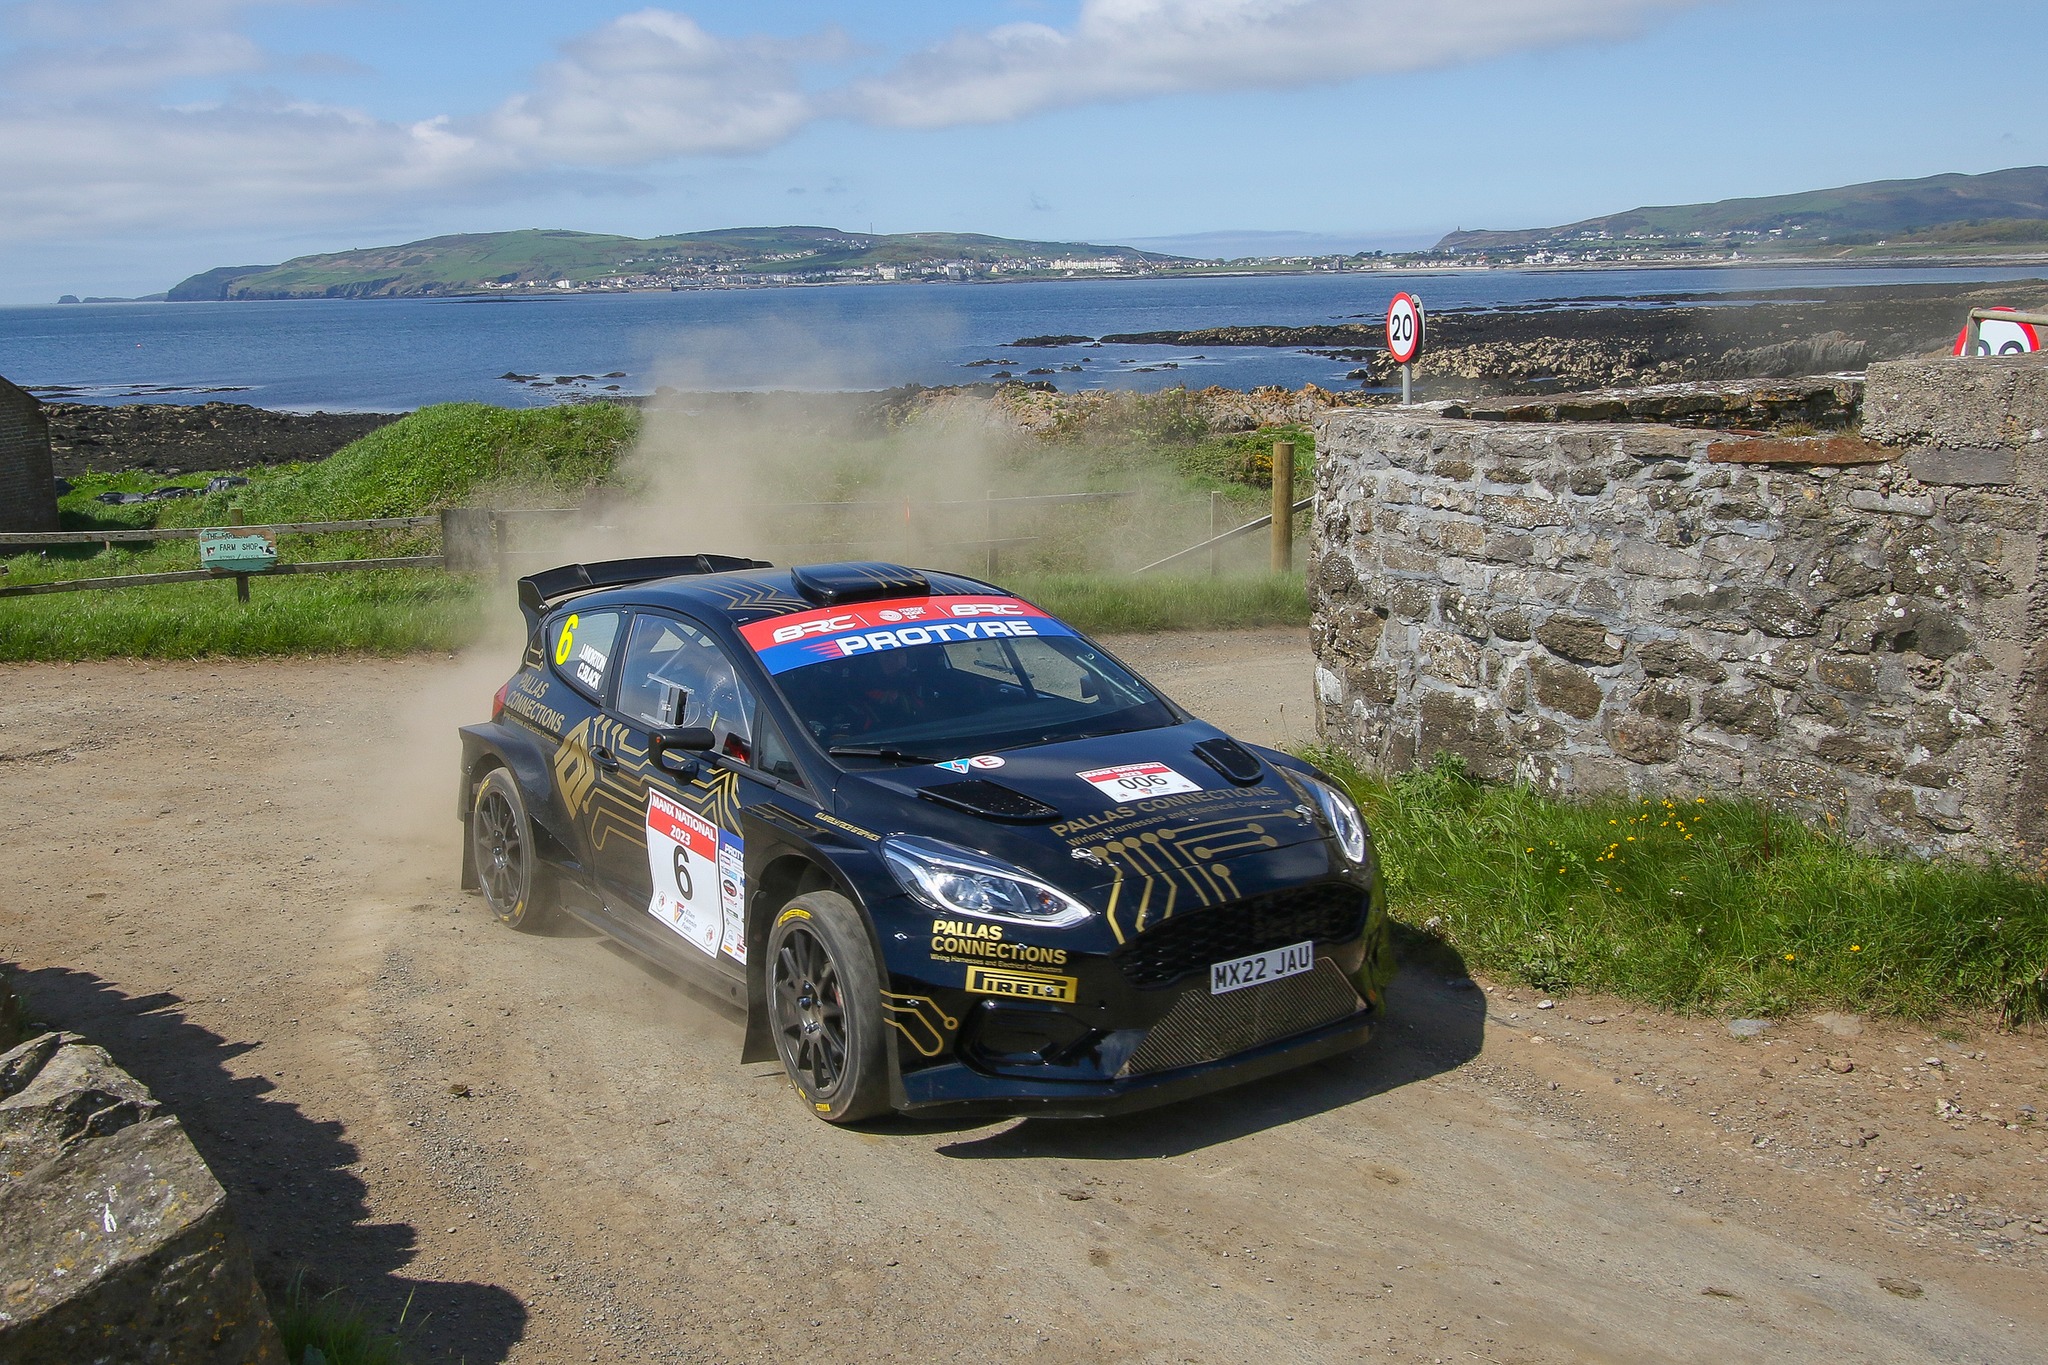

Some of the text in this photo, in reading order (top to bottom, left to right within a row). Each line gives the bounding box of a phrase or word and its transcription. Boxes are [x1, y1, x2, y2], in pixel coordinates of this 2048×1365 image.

[1392, 314, 1413, 341] 20
[220, 542, 259, 551] FARM SHOP
[950, 603, 1026, 617] BRC
[555, 613, 579, 666] 6
[772, 614, 857, 644] BRC
[834, 620, 1039, 656] PROTYRE
[516, 673, 549, 699] PALLAS
[506, 690, 565, 733] CONNECTIONS
[976, 757, 999, 767] E
[1118, 775, 1168, 790] 006
[652, 794, 716, 842] MANX NATIONAL
[1050, 786, 1279, 837] PALLAS CONNECTIONS
[1066, 831, 1107, 847] Wiring
[1105, 815, 1167, 835] Harnesses
[1167, 811, 1188, 820] and
[1187, 802, 1237, 815] Electrical
[670, 824, 691, 846] 2023
[673, 845, 693, 901] 6
[932, 919, 1003, 941] PALLAS
[931, 936, 1068, 965] CONNECTIONS
[1215, 945, 1310, 989] MX22 JAU
[973, 970, 1068, 999] PIRELLI
